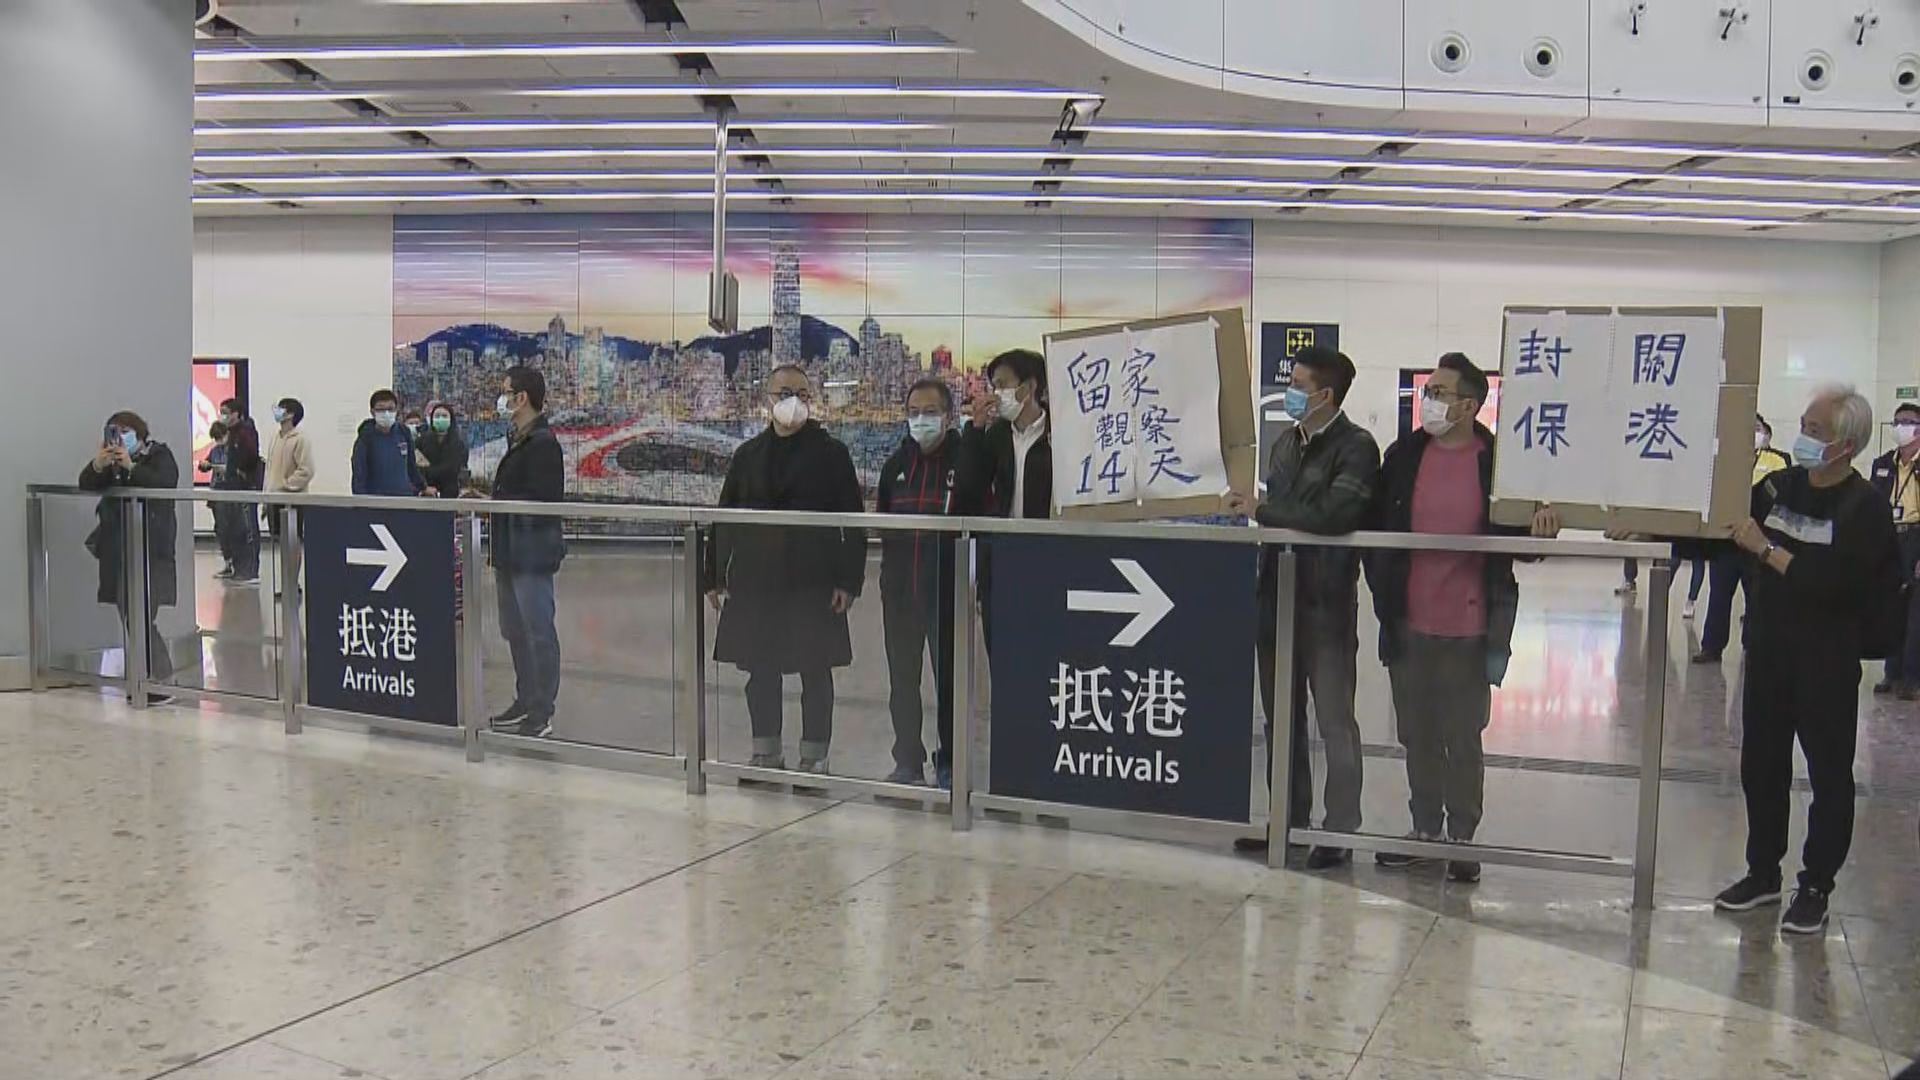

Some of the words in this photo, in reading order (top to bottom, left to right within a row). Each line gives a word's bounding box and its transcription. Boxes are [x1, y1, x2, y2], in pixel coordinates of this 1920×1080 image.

[1067, 348, 1160, 414] 留家
[1095, 405, 1181, 449] 觀察
[1513, 402, 1687, 460] 保港
[338, 603, 418, 661] 抵港
[342, 665, 416, 698] Arrivals
[1049, 661, 1187, 737] 抵港
[1053, 742, 1181, 784] Arrivals
